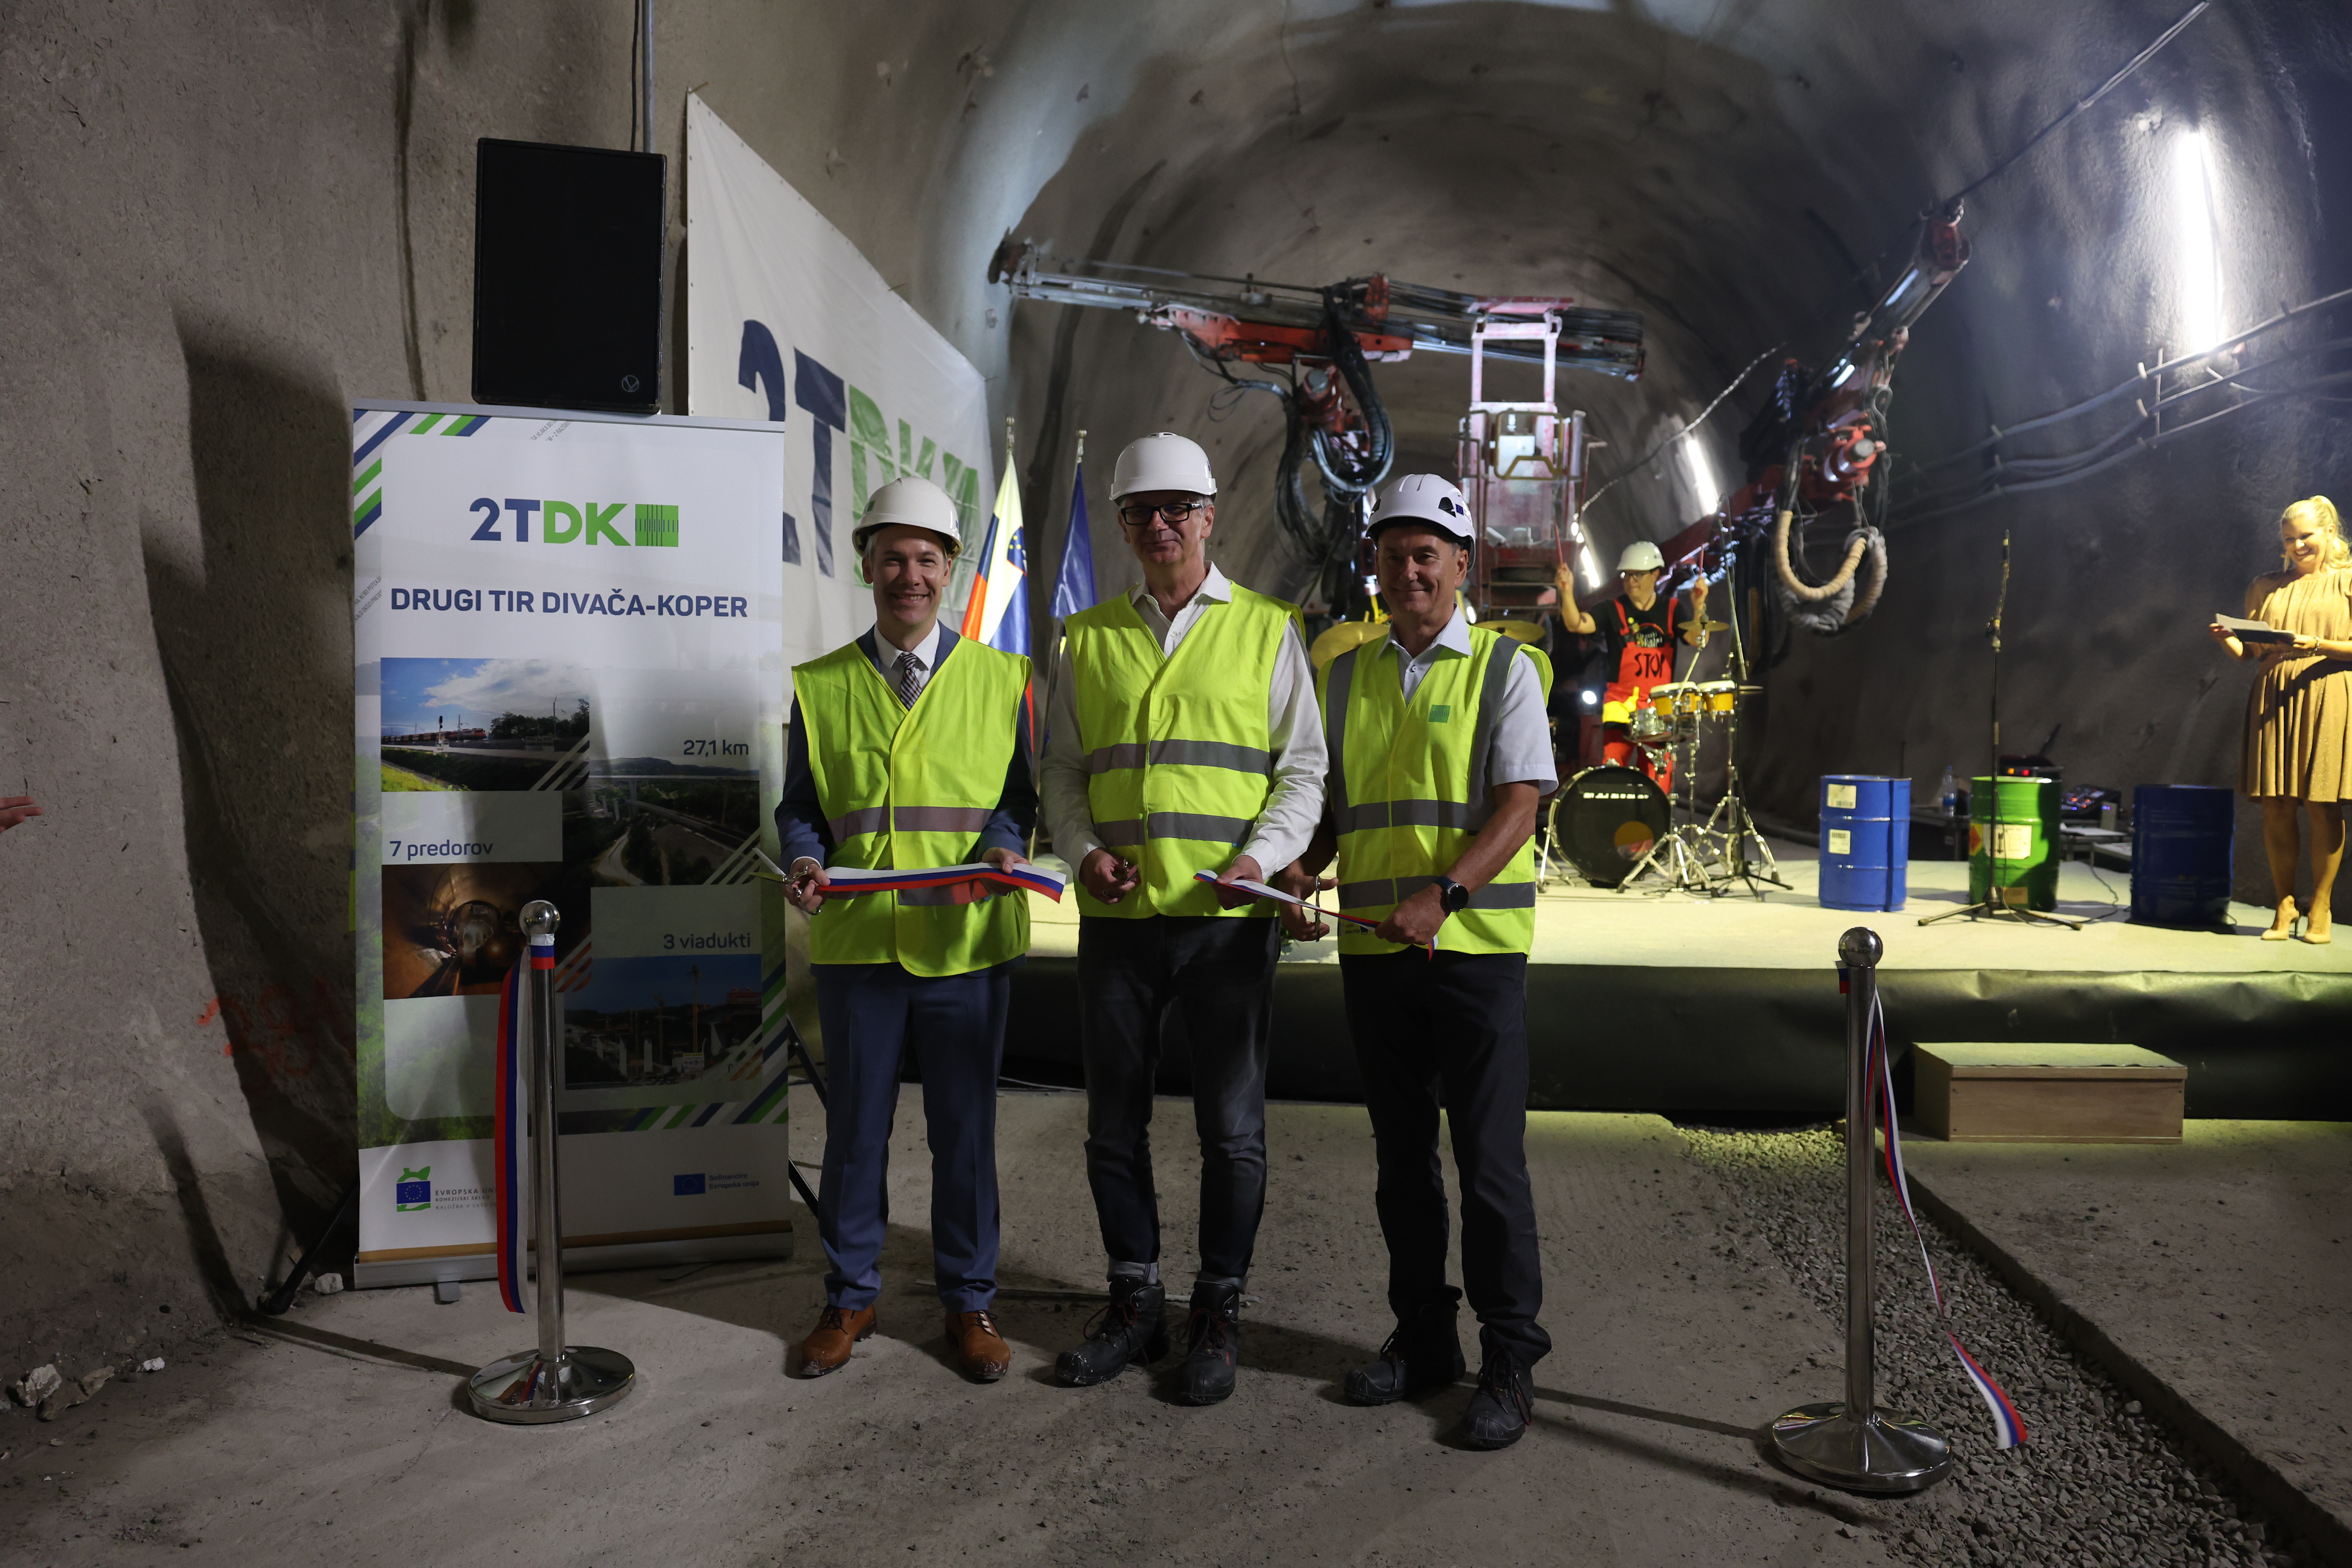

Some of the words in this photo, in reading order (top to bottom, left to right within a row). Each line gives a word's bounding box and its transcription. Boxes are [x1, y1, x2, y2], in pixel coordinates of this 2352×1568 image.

[470, 497, 631, 546] 2TDK
[361, 601, 372, 612] SKOZI
[392, 588, 481, 611] DRUGI
[489, 590, 534, 612] TIR
[543, 588, 748, 617] DIVAČA-KOPER
[683, 739, 717, 757] 27,1
[722, 739, 749, 755] km
[390, 840, 401, 857] 7
[407, 839, 494, 861] predorov
[663, 934, 675, 949] 3
[679, 932, 751, 949] viadukti
[435, 1188, 478, 1196] EVROPSKA
[709, 1181, 741, 1189] Evropska
[743, 1180, 759, 1188] unija
